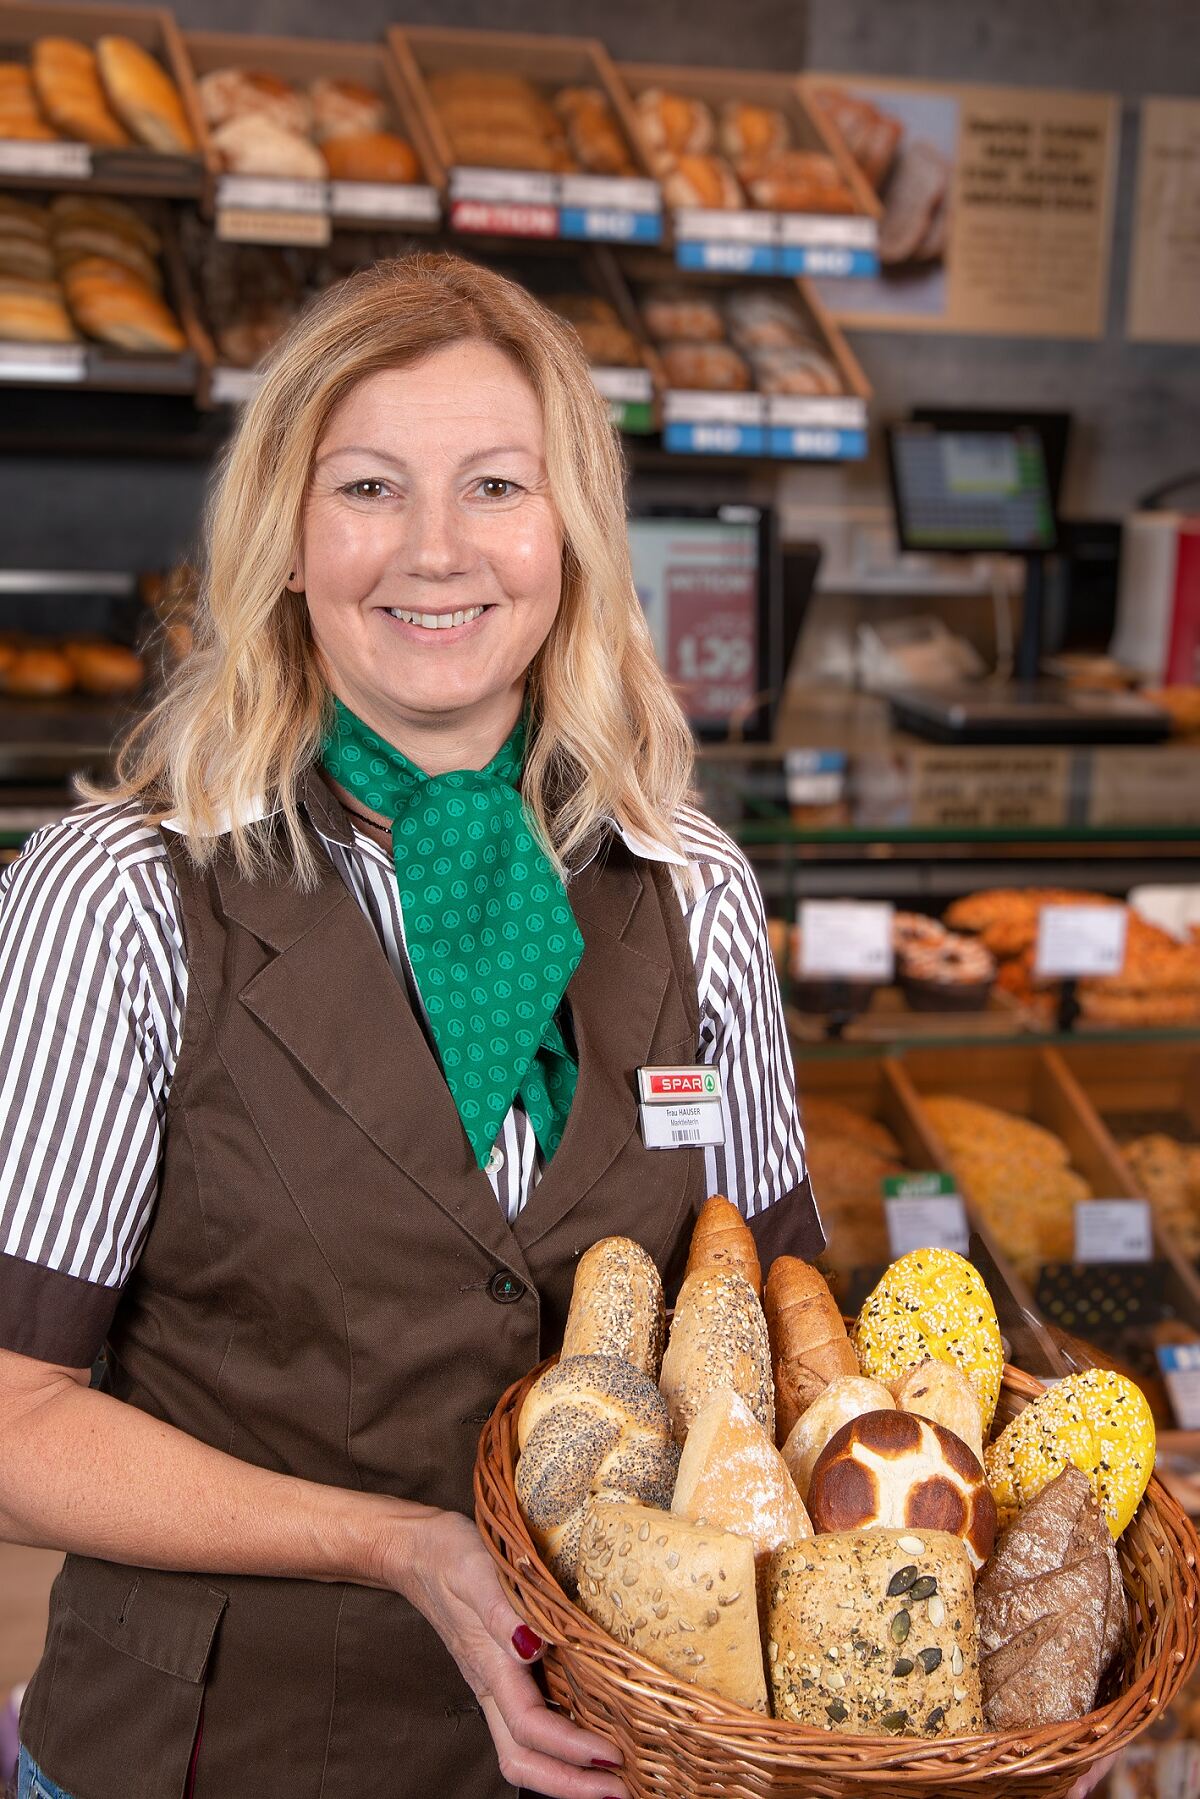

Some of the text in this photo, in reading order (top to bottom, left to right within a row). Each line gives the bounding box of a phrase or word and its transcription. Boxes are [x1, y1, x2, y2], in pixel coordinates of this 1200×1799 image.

[661, 1078, 702, 1090] SPAR
[666, 1108, 701, 1117] Frau HAUSER
